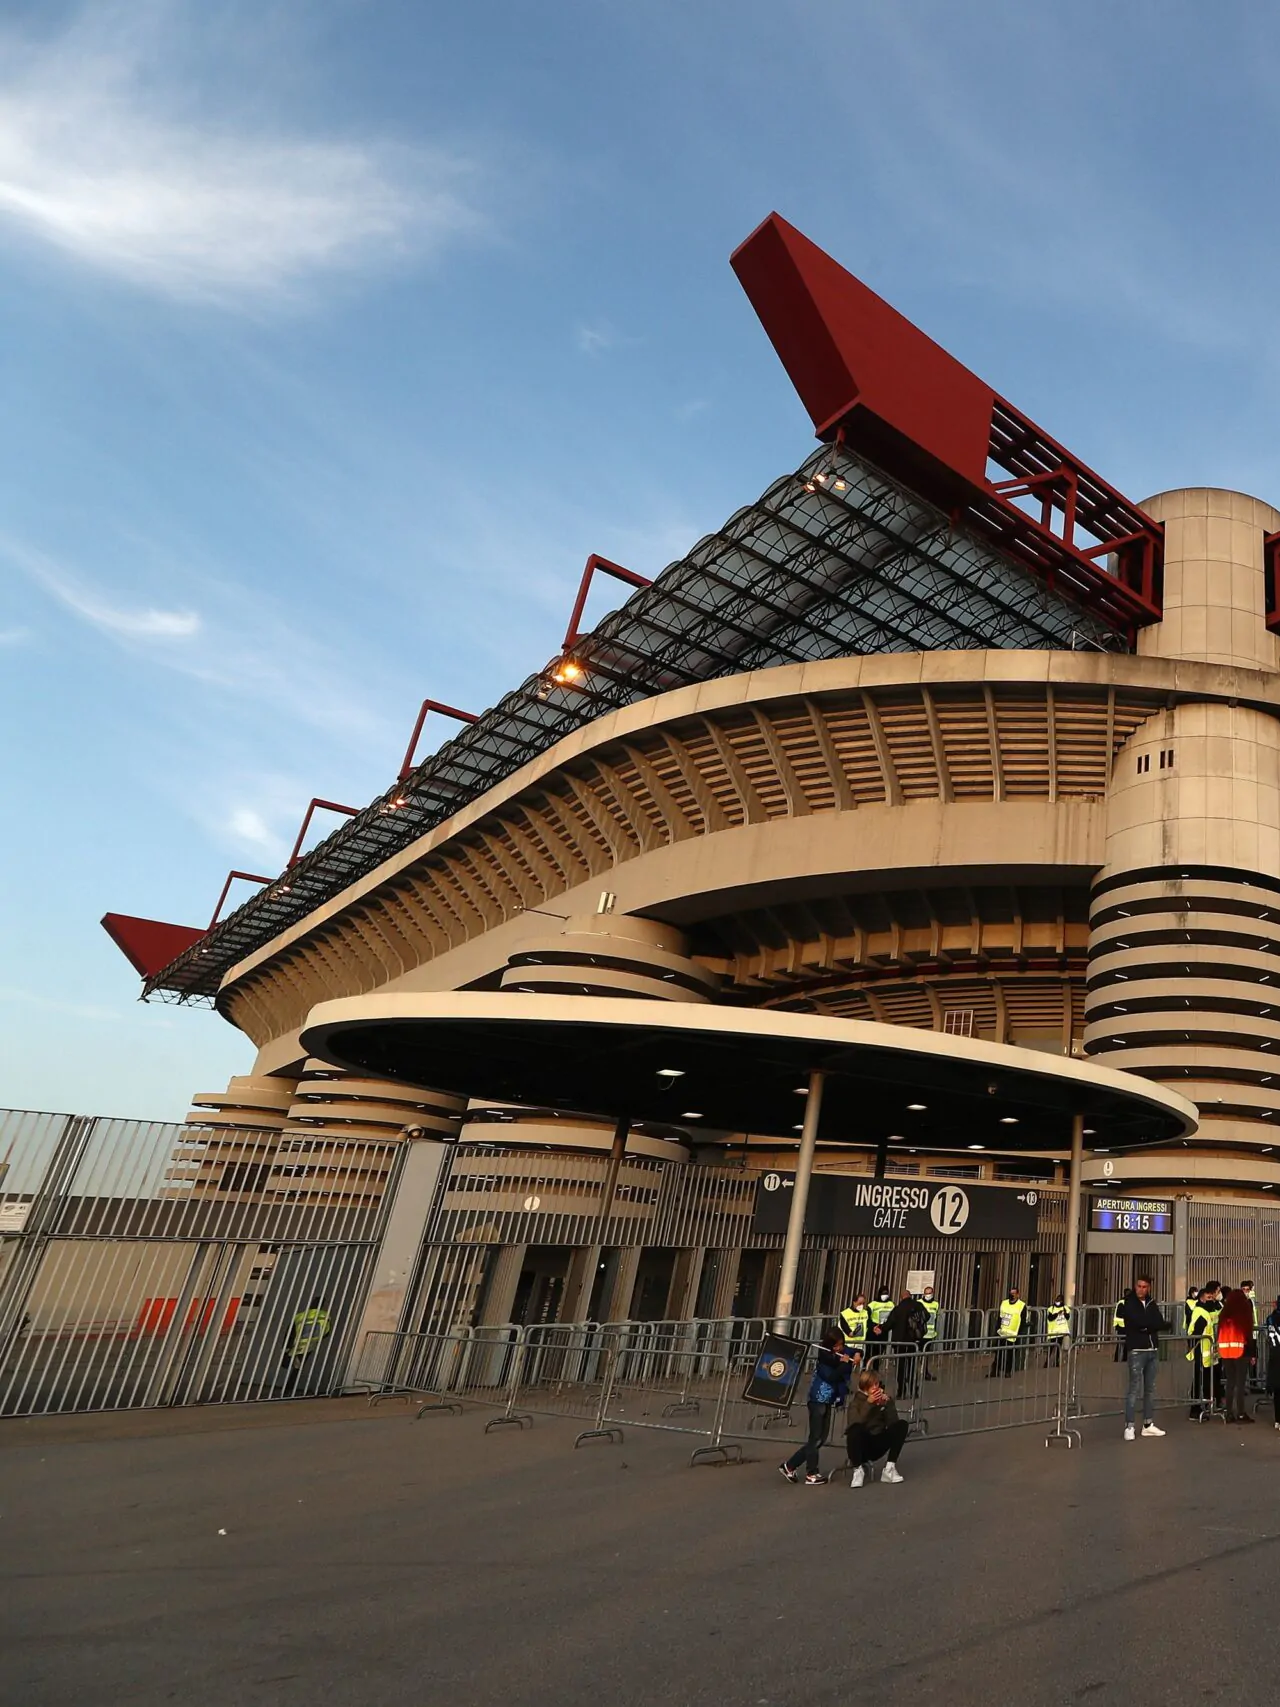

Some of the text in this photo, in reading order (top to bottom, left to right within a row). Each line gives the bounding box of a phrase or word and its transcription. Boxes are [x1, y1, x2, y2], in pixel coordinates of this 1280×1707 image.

[854, 1184, 929, 1209] INGRESSO
[1097, 1199, 1167, 1212] APERTURA INGRESSI
[873, 1207, 909, 1229] GATE
[937, 1191, 964, 1228] 12
[1116, 1213, 1150, 1230] 18:15
